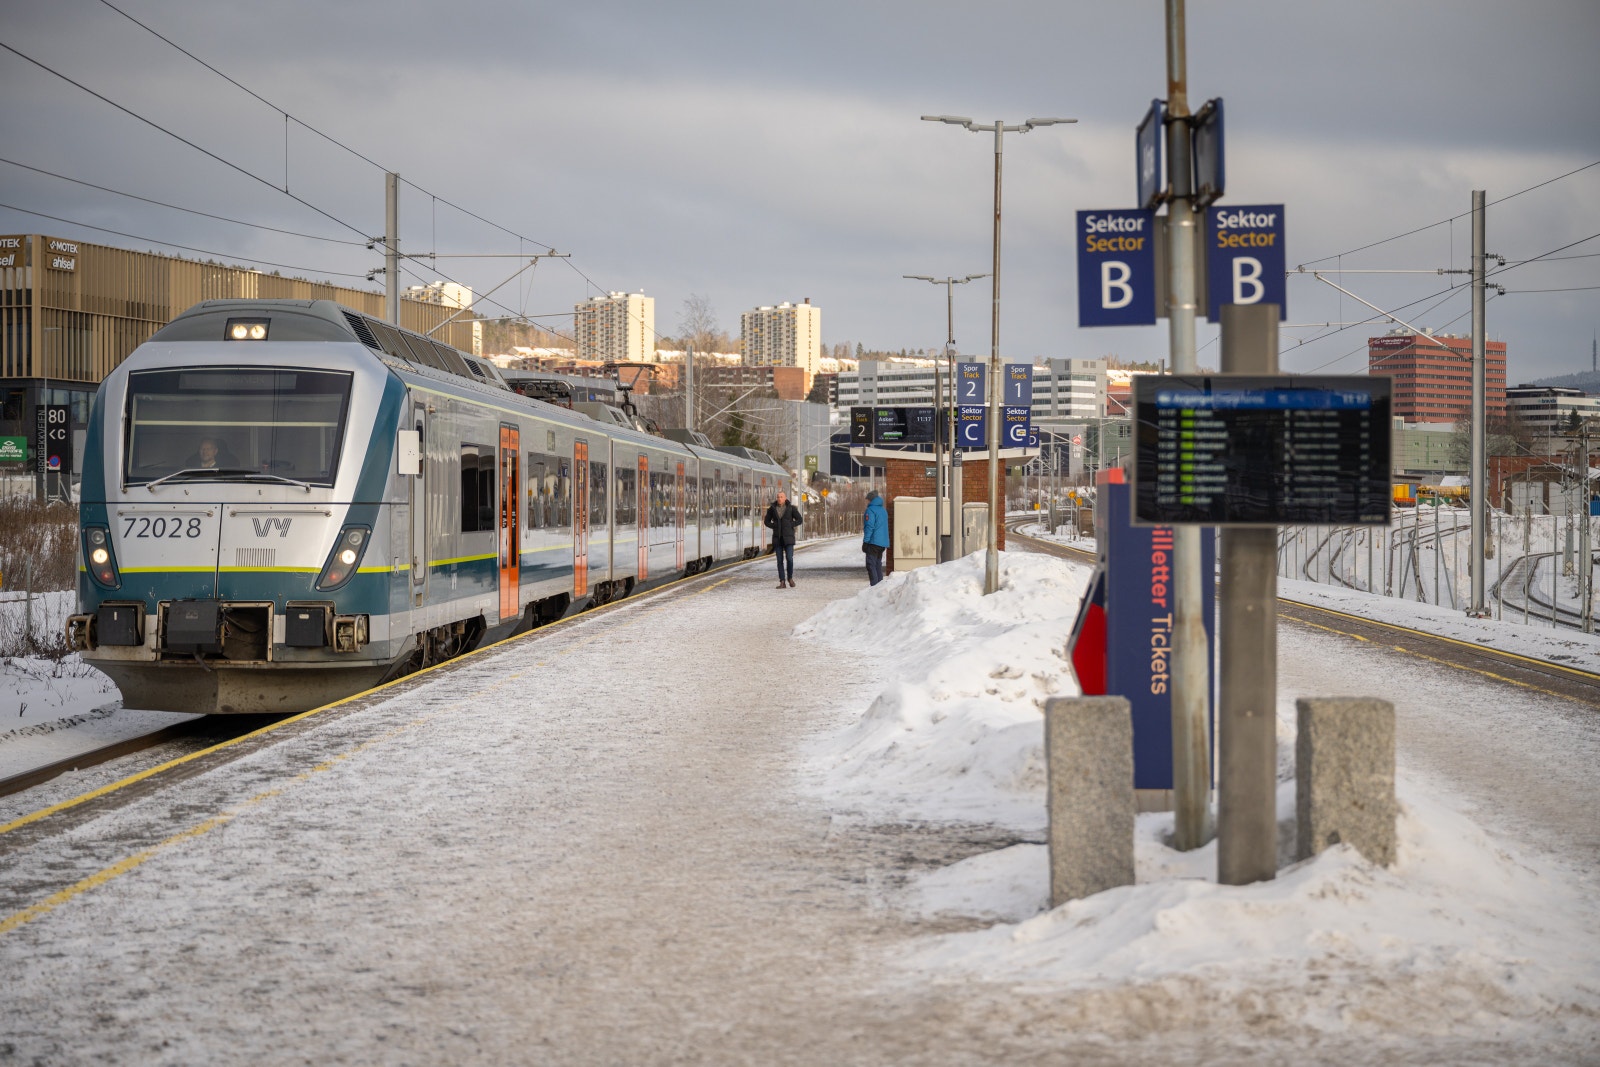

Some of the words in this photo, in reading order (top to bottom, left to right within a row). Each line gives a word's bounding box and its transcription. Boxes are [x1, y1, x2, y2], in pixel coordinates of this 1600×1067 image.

[1085, 214, 1145, 233] Sektor
[1217, 210, 1276, 229] Sektor
[56, 241, 78, 253] MOTEK
[1086, 235, 1145, 252] Sector
[1217, 230, 1276, 248] Sector
[52, 256, 75, 270] ahlsell
[1101, 260, 1133, 309] B
[1232, 257, 1265, 305] B
[963, 364, 978, 372] Spor
[966, 381, 976, 397] 2
[1015, 382, 1021, 398] 1
[48, 409, 66, 424] 80
[57, 429, 66, 440] C
[858, 424, 866, 437] 2
[965, 423, 979, 441] C
[1010, 424, 1023, 441] C
[123, 517, 201, 538] 72028
[1151, 526, 1174, 608] illetter
[1151, 612, 1173, 695] Tickets
